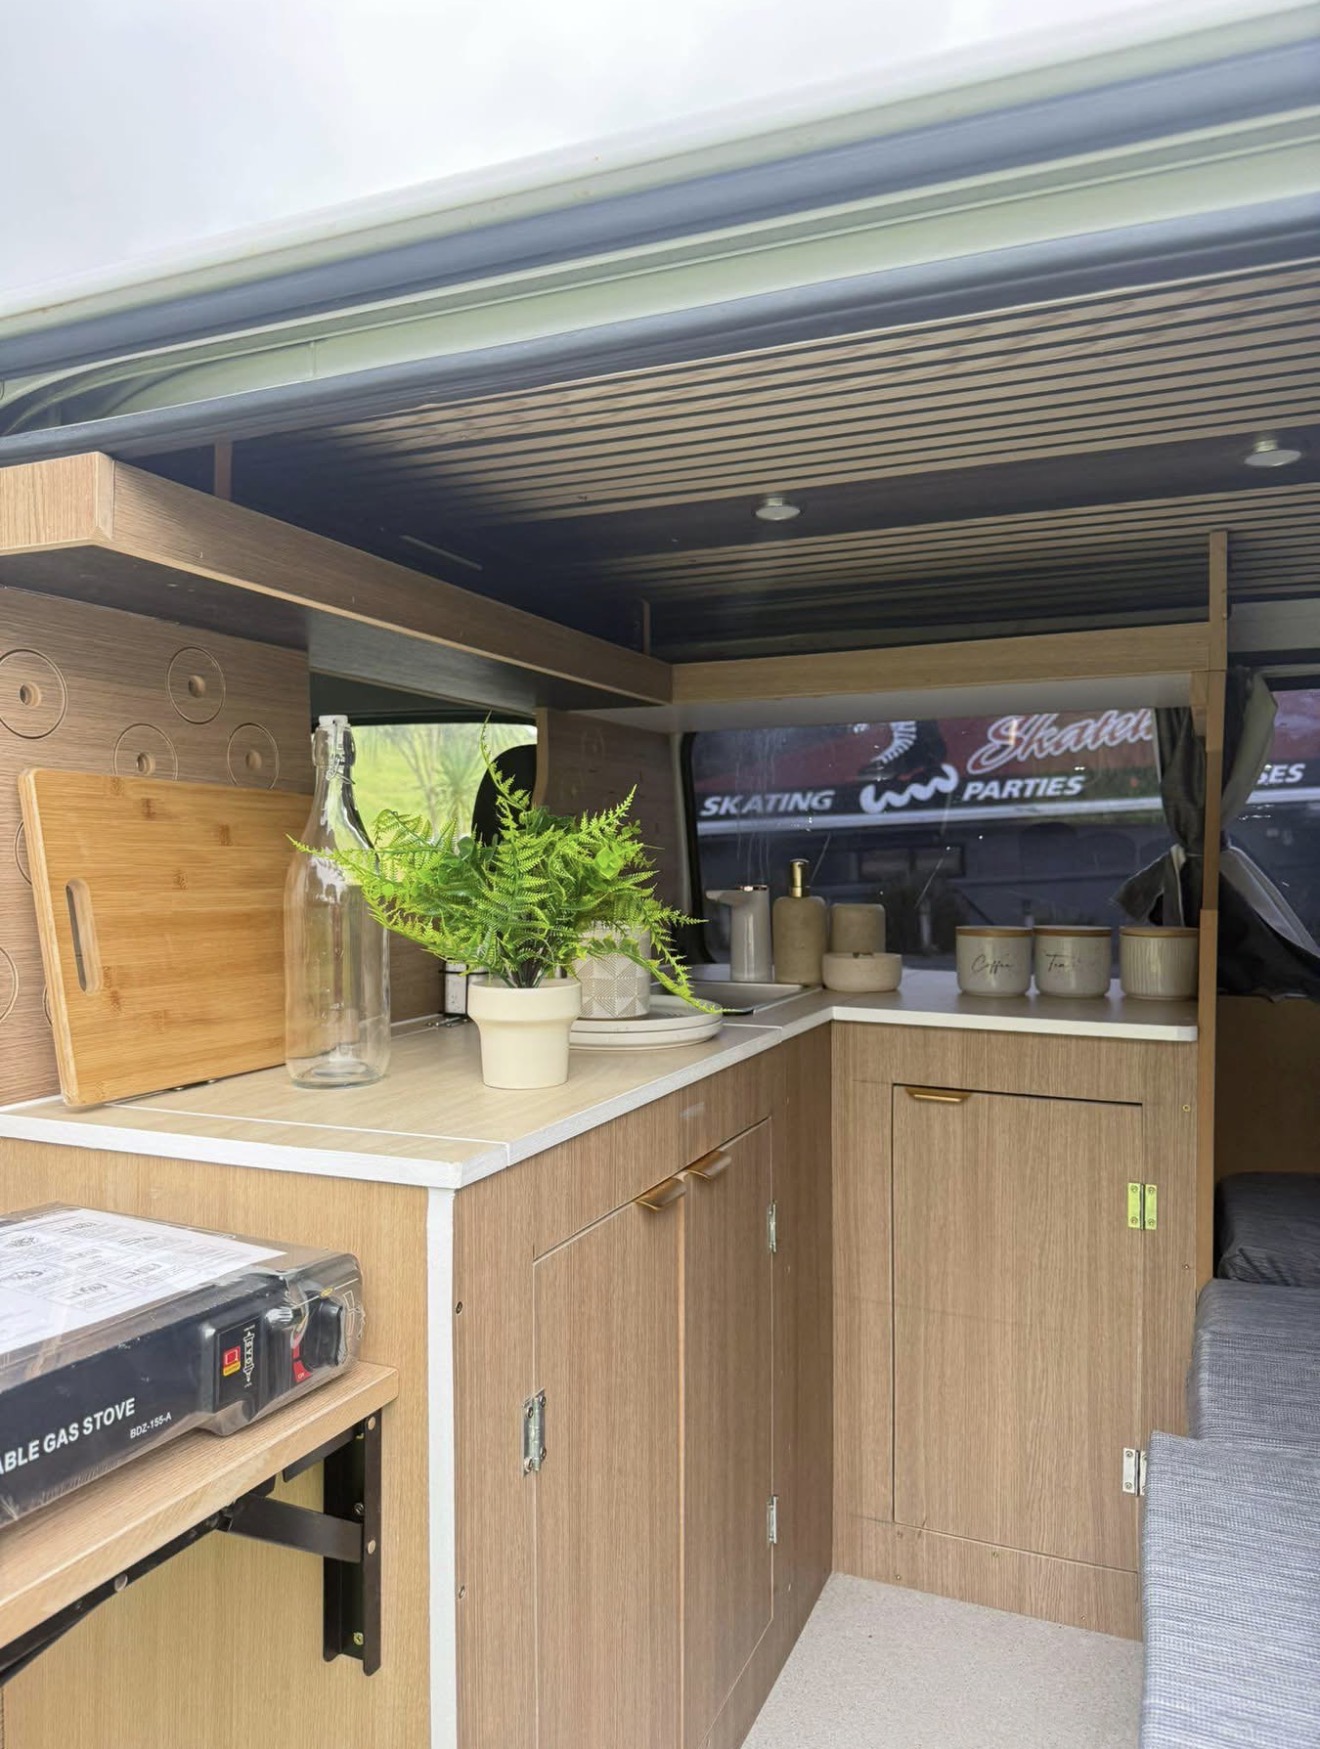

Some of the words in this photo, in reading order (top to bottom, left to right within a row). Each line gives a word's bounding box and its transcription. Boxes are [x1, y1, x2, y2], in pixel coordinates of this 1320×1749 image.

[700, 789, 836, 817] SKATING
[961, 775, 1086, 801] PARTIES
[43, 1423, 79, 1453] GAS
[82, 1397, 136, 1435] STOVE
[129, 1411, 172, 1439] BDZ-155-A
